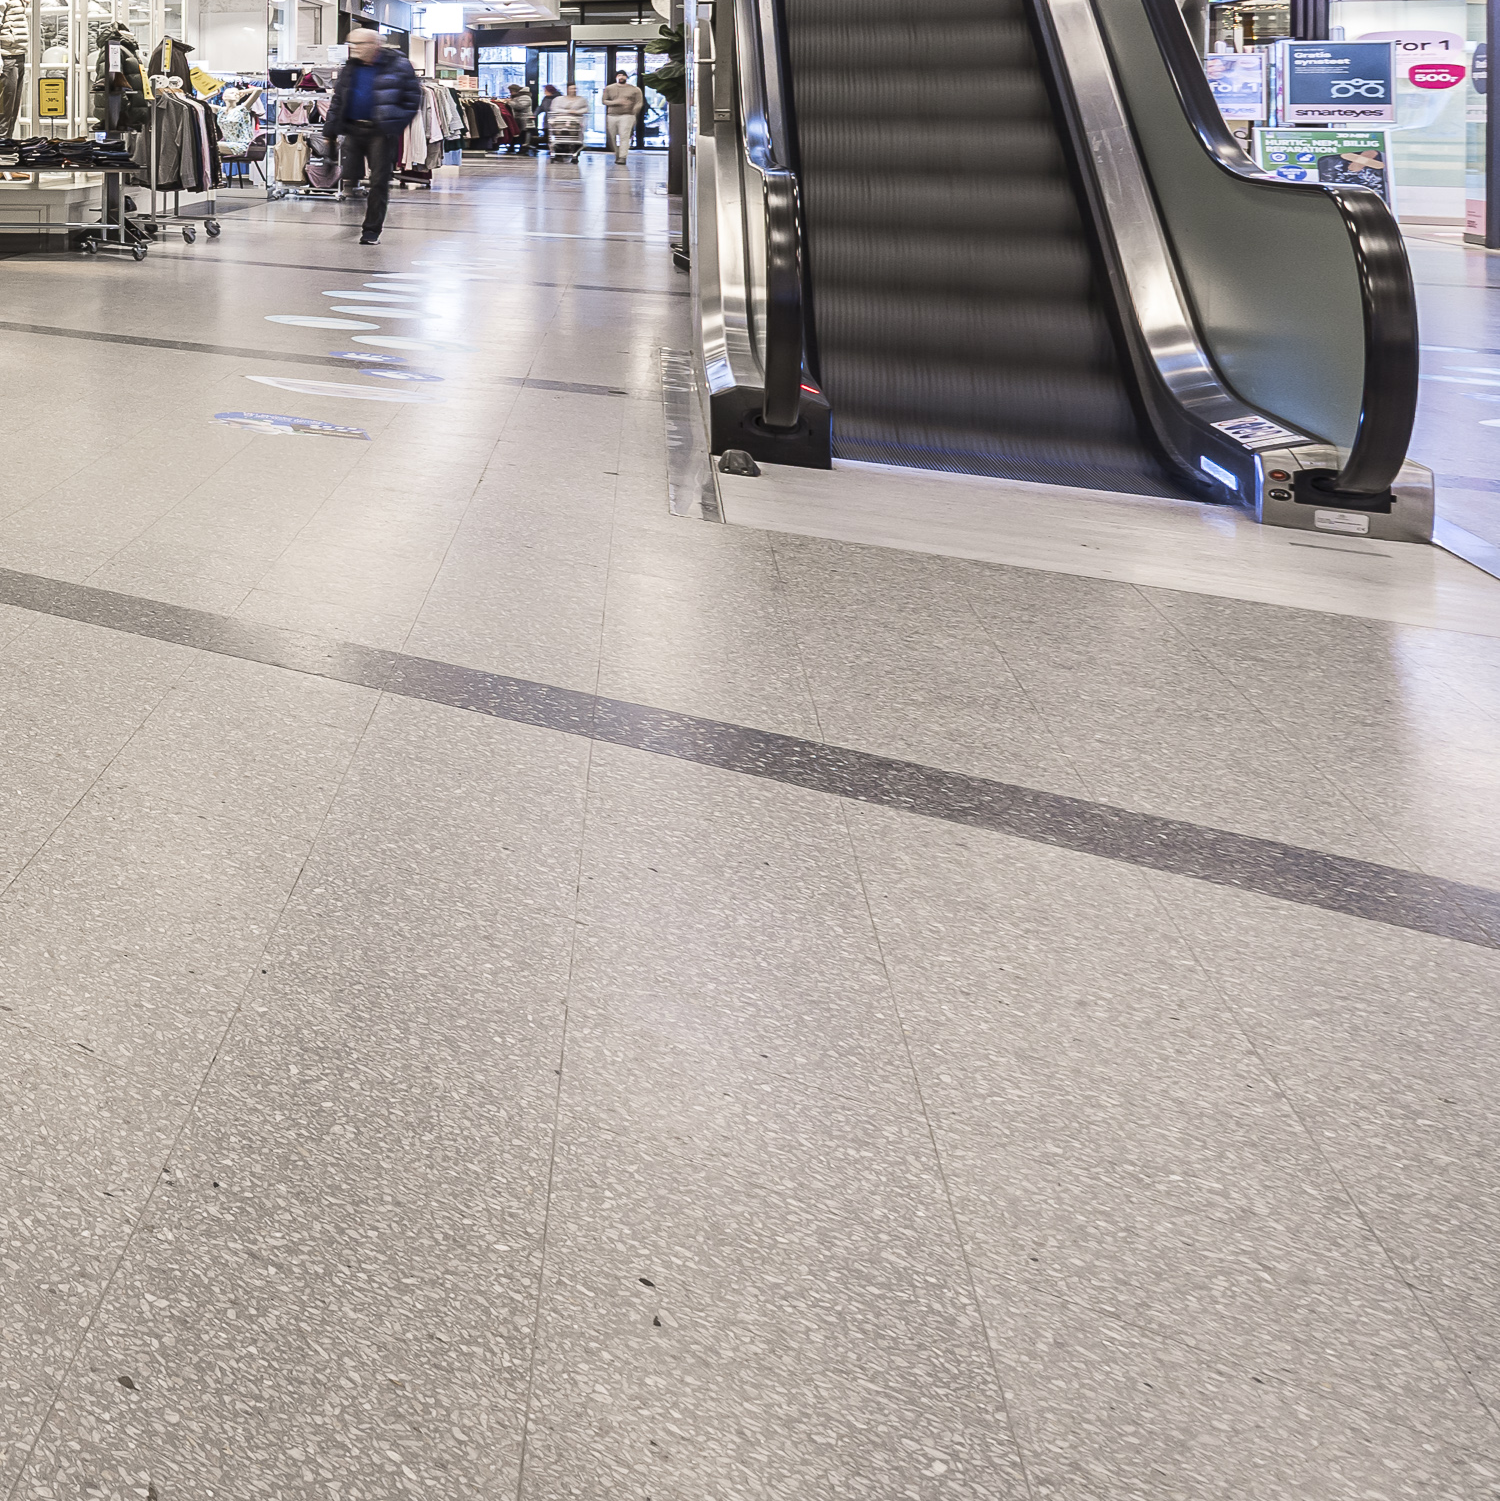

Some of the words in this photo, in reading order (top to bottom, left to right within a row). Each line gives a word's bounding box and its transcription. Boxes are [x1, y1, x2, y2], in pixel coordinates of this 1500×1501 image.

[1439, 40, 1449, 51] 1
[1247, 82, 1258, 93] 1
[1295, 109, 1384, 118] smarteyes
[1343, 140, 1380, 148] BILLIG
[1265, 146, 1338, 154] REPARATION
